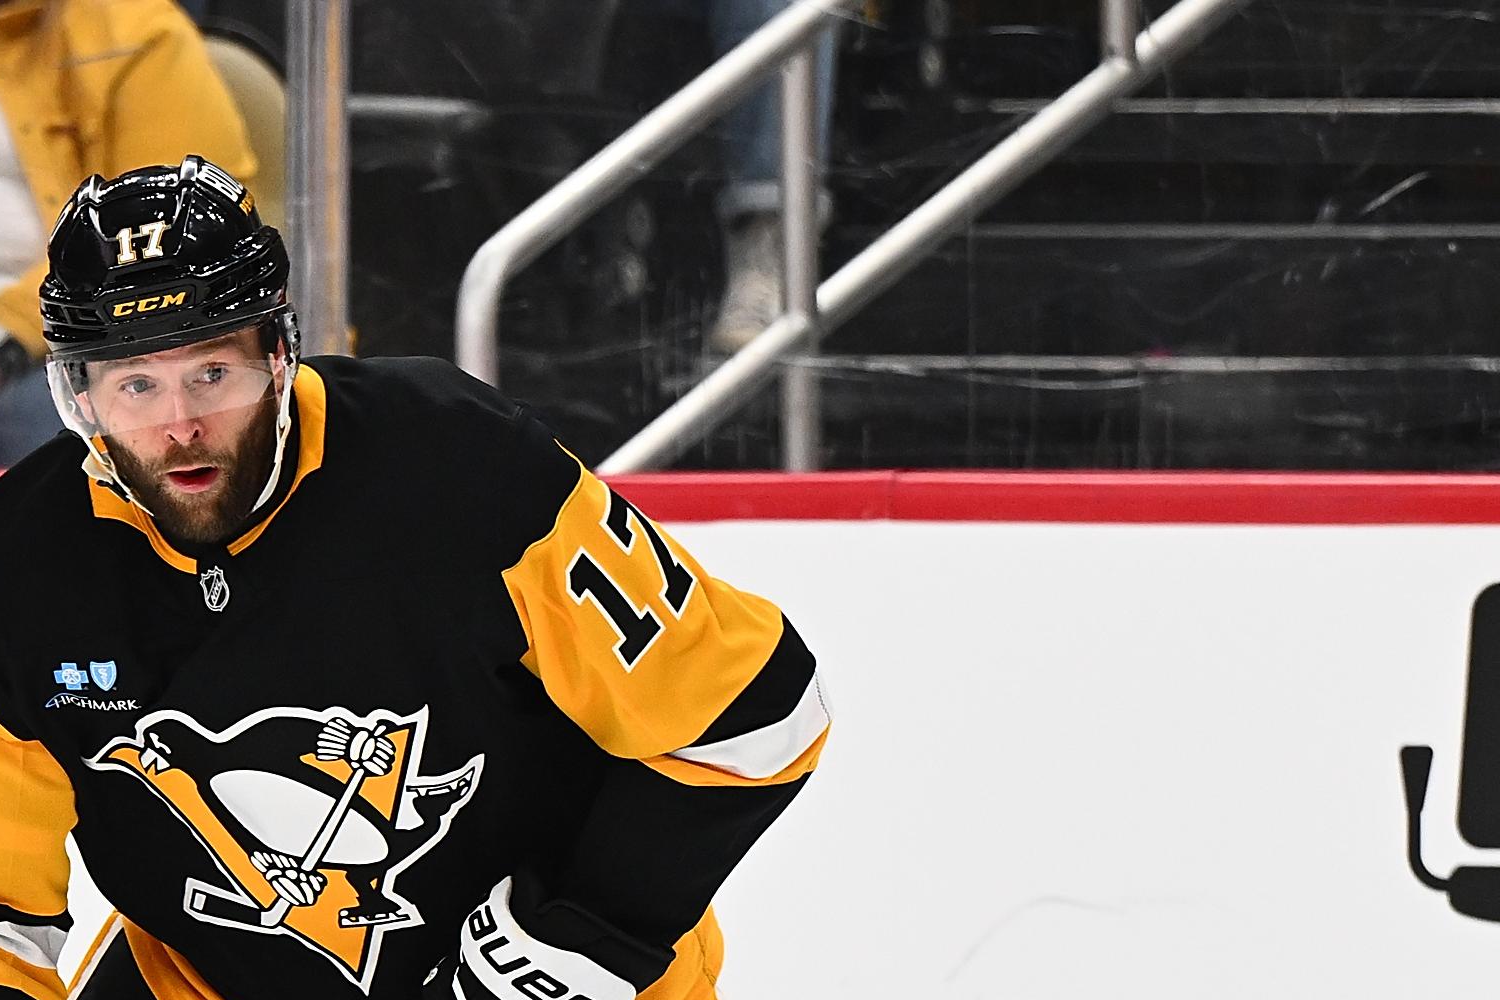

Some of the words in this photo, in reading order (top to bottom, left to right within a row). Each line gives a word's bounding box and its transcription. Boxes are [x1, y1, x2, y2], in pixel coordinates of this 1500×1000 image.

[116, 220, 167, 264] 17
[113, 292, 186, 317] CCM
[565, 483, 696, 673] 17
[45, 693, 141, 711] HIGHMARK
